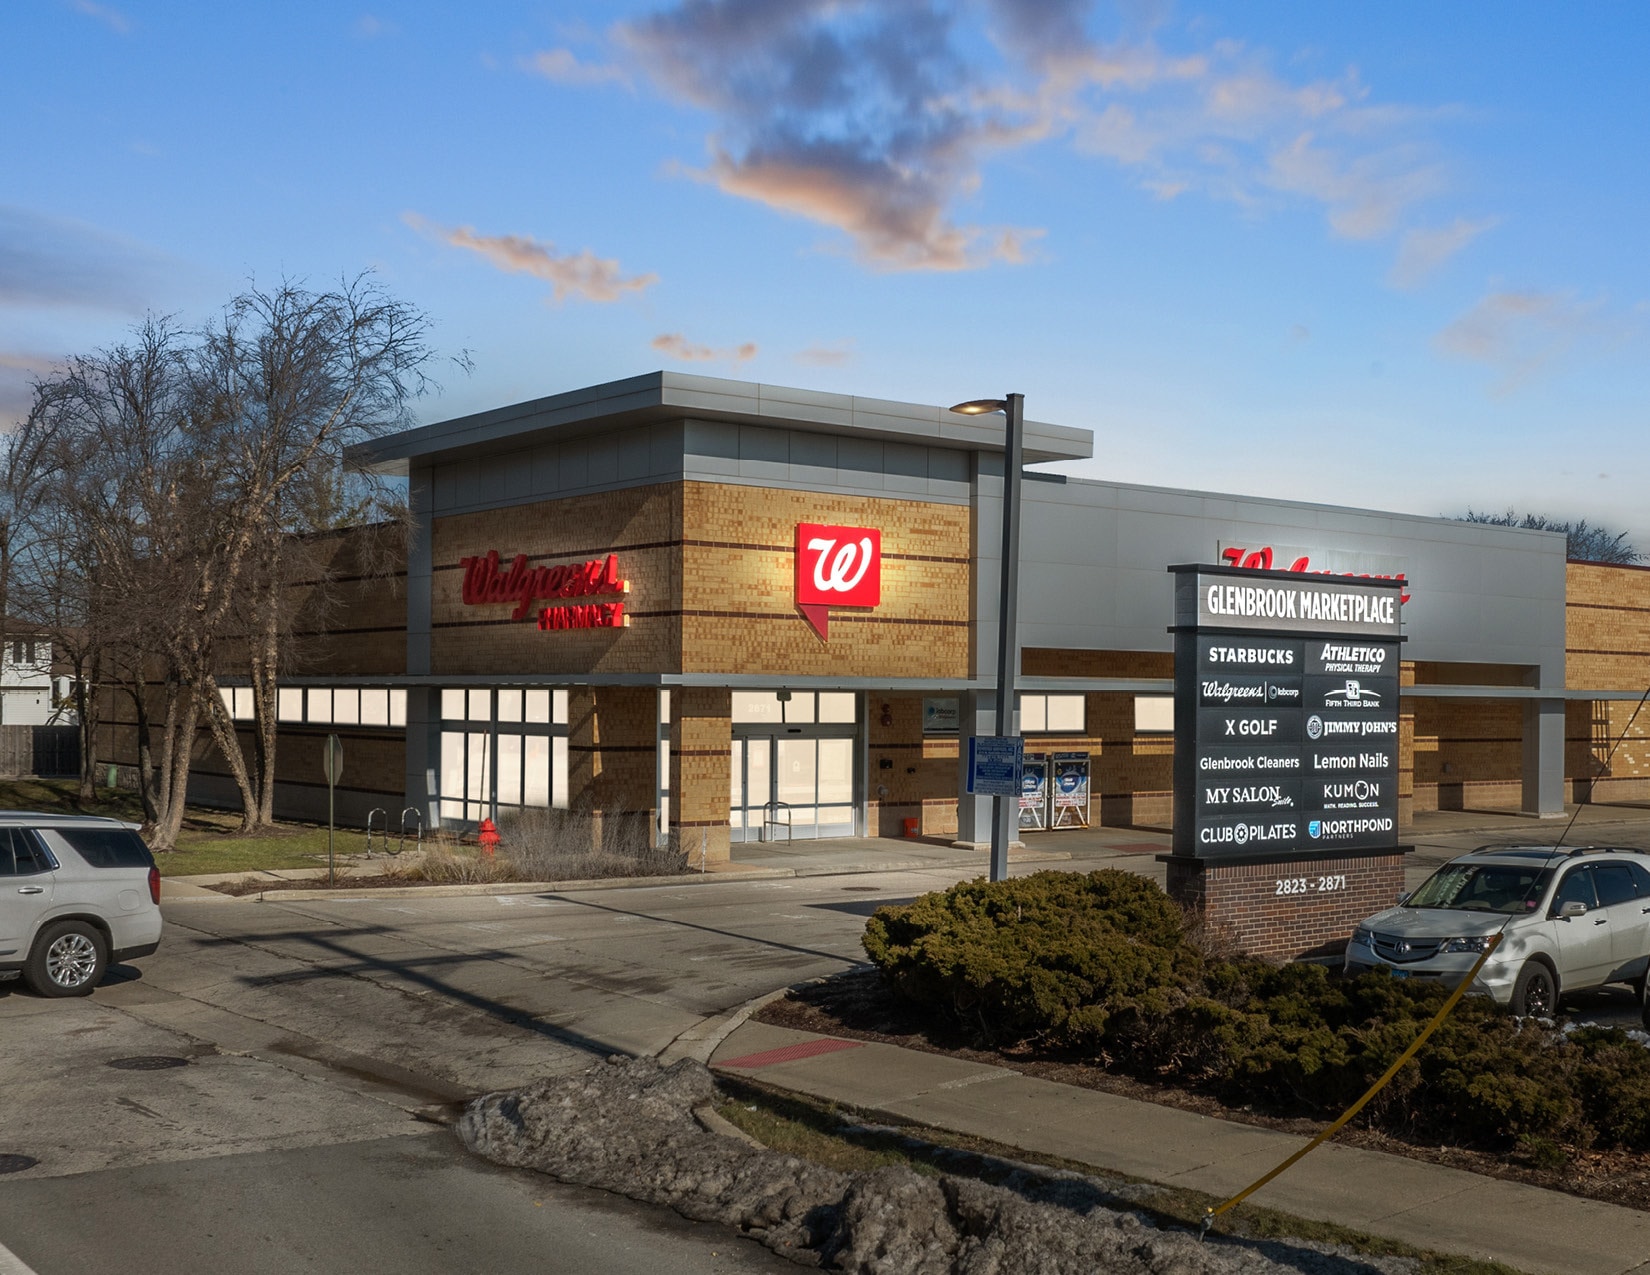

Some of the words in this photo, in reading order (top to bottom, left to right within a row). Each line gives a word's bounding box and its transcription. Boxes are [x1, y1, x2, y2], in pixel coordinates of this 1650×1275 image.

[806, 537, 873, 592] W
[460, 550, 629, 620] Walgreens
[1207, 585, 1297, 619] GLENBROOK
[1300, 591, 1395, 624] MARKETPLACE
[1209, 647, 1294, 664] STARBUCKS
[1324, 663, 1353, 672] PHYSICAL
[1355, 664, 1381, 673] THERAPY
[1202, 681, 1264, 702] Walgreens
[1277, 687, 1299, 697] labcorp
[1325, 699, 1342, 707] FIFTH
[1225, 719, 1236, 736] X
[1239, 719, 1278, 735] GOLF
[1323, 721, 1360, 736] JIMMY
[1361, 721, 1397, 736] JOHN'S
[1200, 757, 1255, 770] Glenbrook
[1257, 756, 1300, 768] Cleaners
[1314, 754, 1356, 769] Lemon
[1359, 752, 1389, 768] Nails
[1206, 788, 1231, 804] MY
[1232, 786, 1281, 803] SALON
[1323, 780, 1380, 800] KUMON
[1200, 827, 1234, 843] CLUB
[1249, 824, 1297, 841] PILATES
[1322, 818, 1393, 834] NORTHPOND
[1276, 878, 1307, 895] 2823
[1318, 875, 1346, 892] 2871
